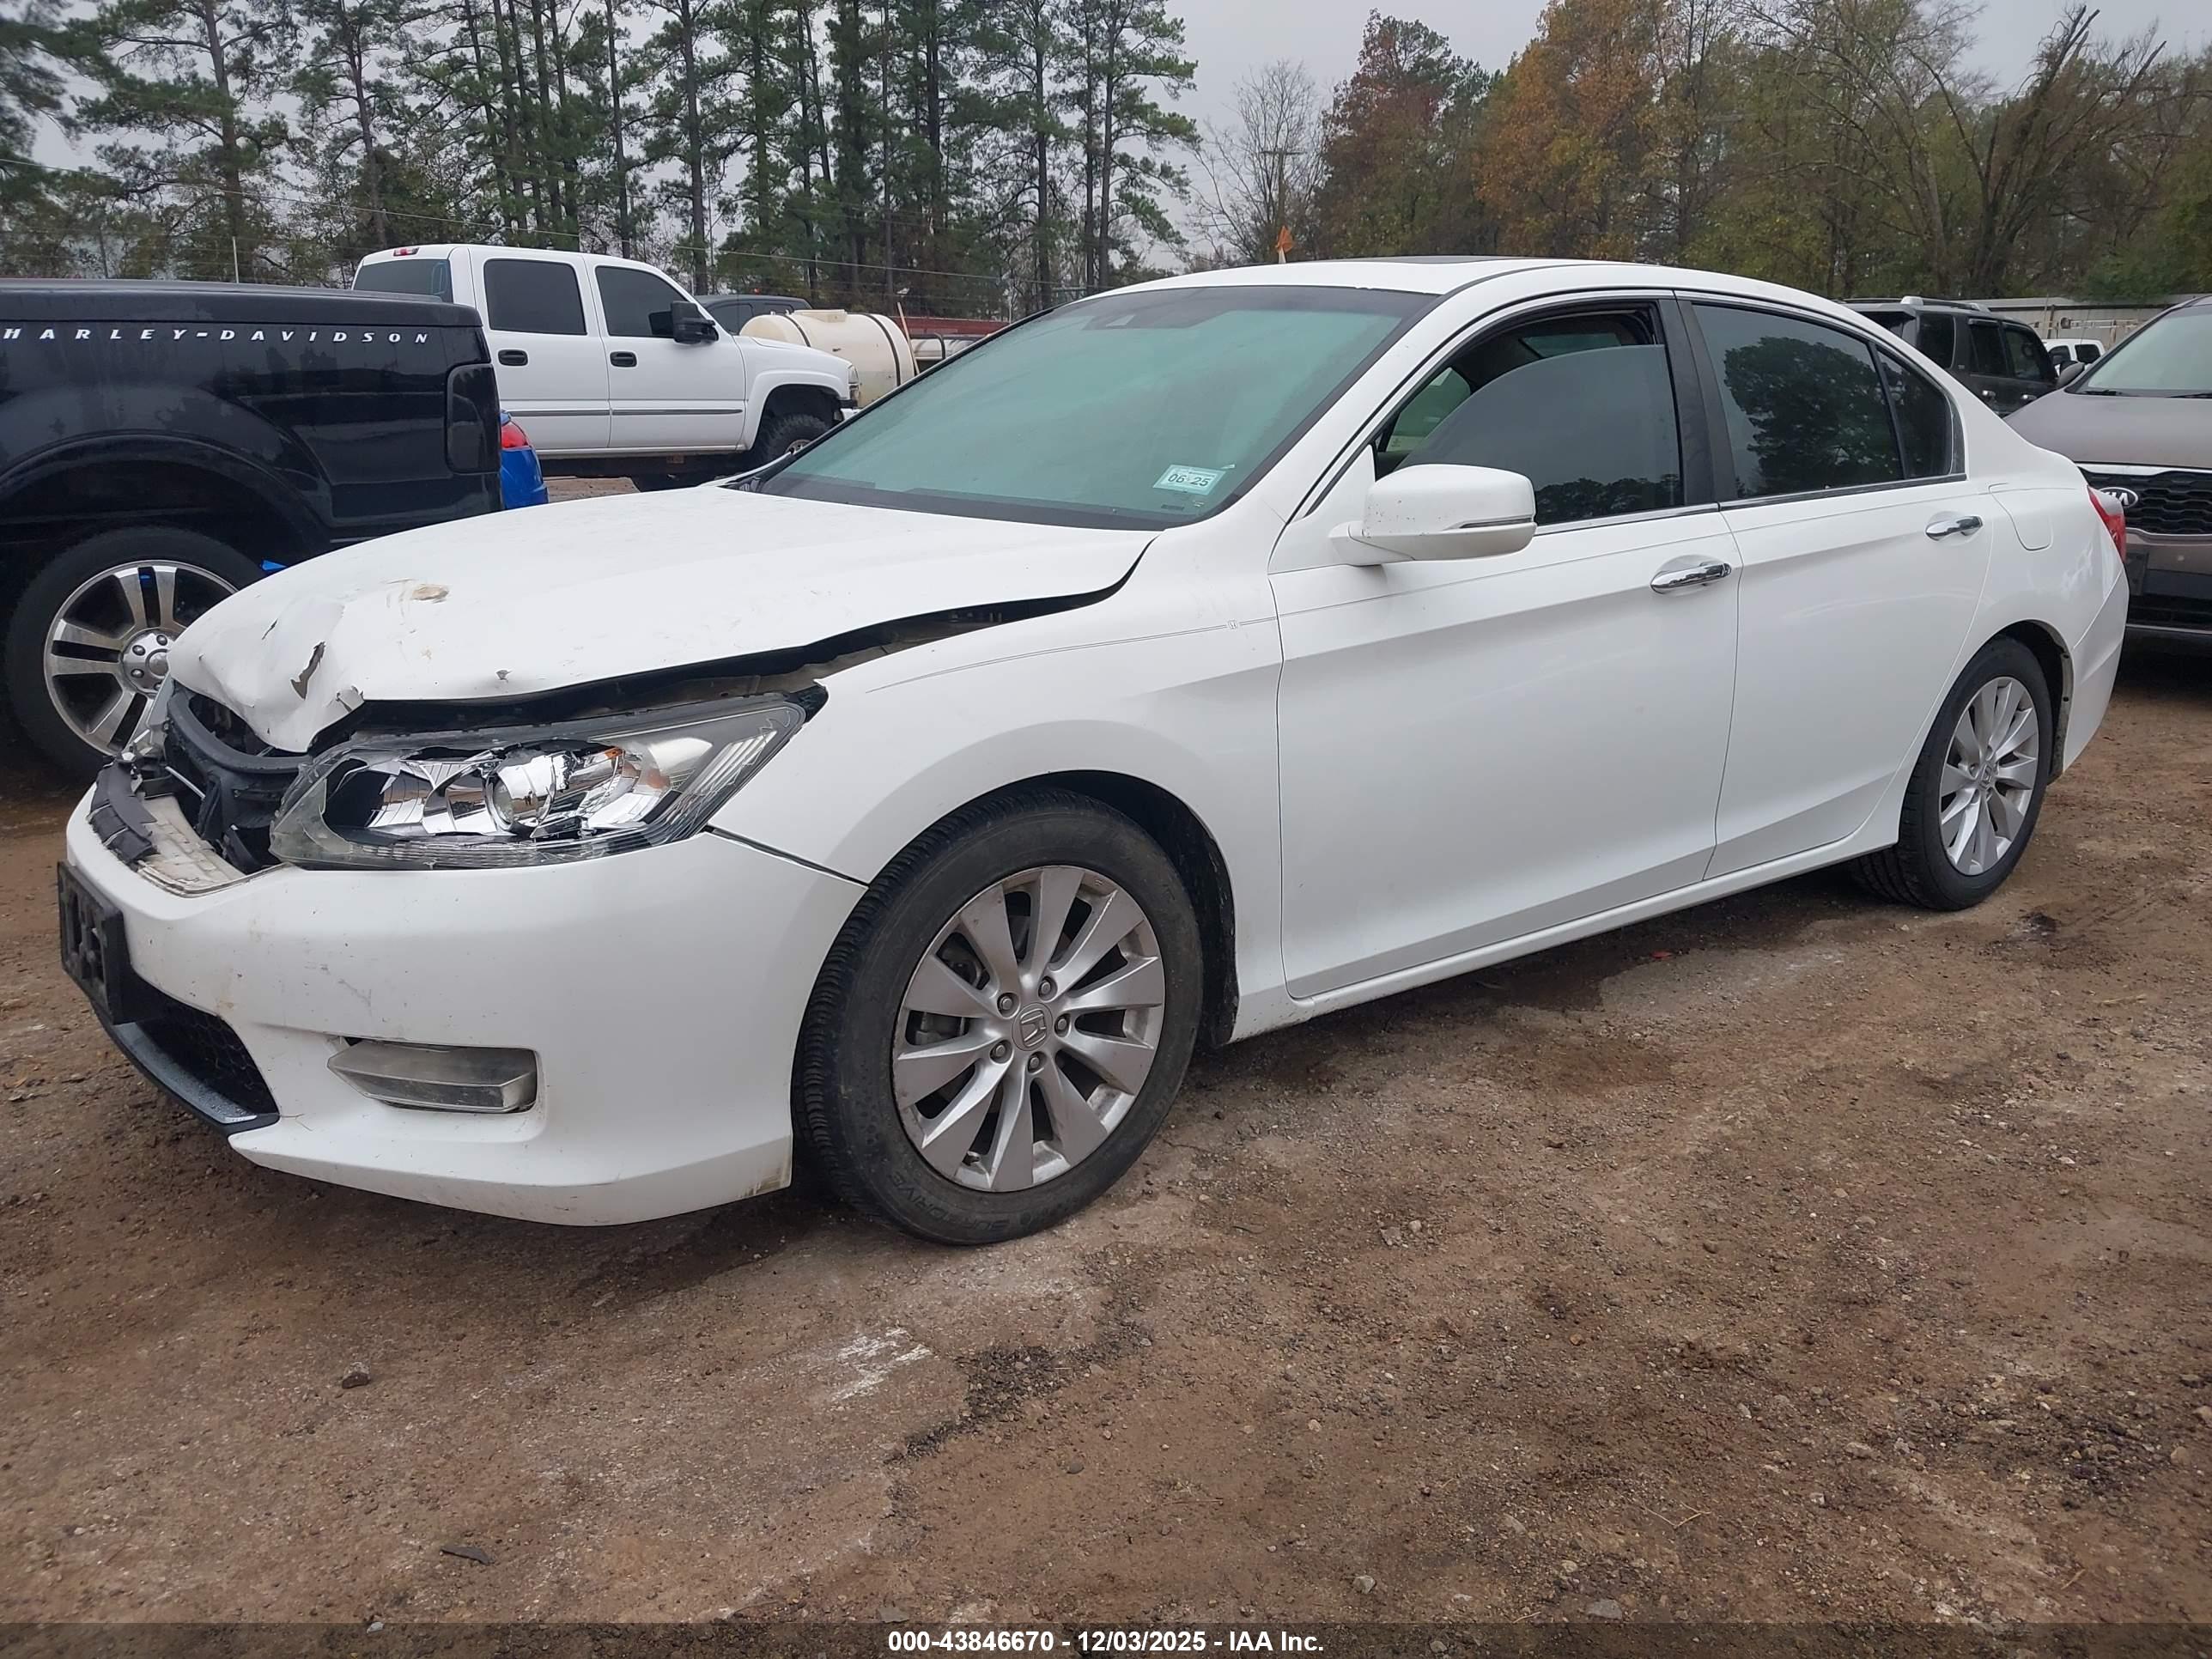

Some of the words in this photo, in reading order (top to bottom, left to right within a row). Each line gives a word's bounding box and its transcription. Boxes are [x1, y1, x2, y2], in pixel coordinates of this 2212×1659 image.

[3, 327, 428, 343] HARLEY-DAVIDSON
[1168, 473, 1185, 483] 06
[1190, 477, 1211, 487] 25
